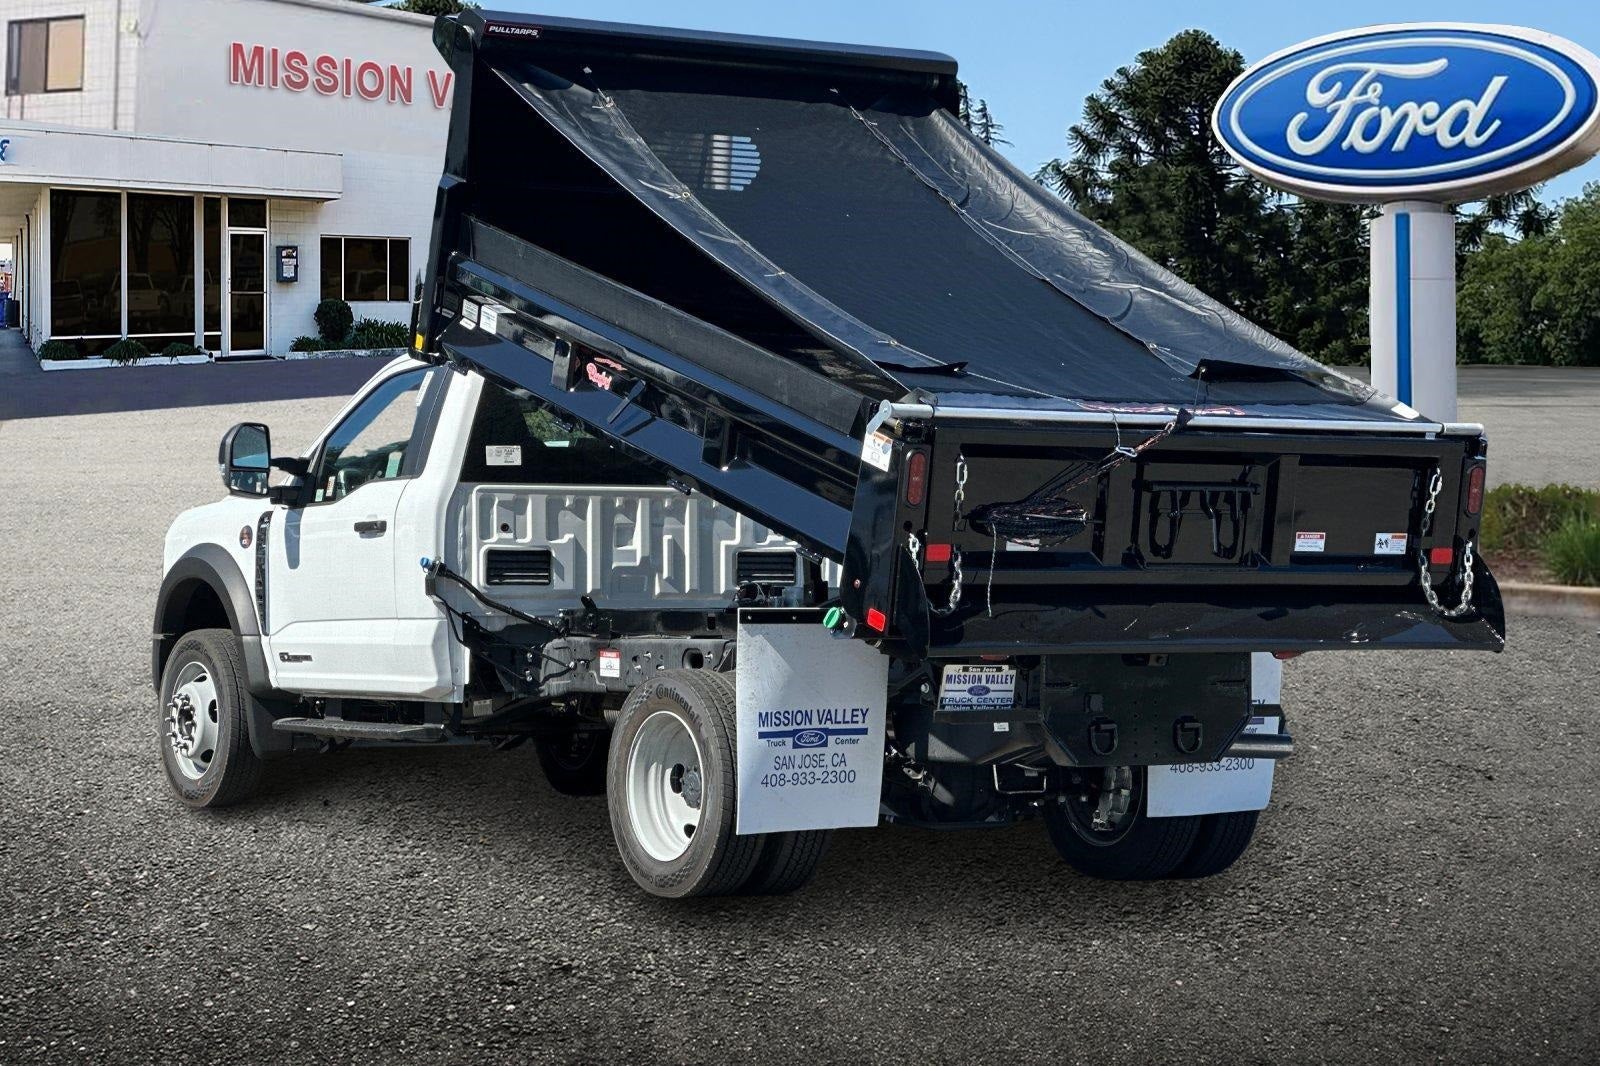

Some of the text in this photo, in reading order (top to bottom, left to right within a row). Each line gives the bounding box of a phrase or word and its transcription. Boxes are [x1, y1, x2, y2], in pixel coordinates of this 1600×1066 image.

[489, 26, 539, 36] PULLTARPS
[230, 41, 413, 105] MISSION
[1286, 57, 1509, 156] Ford
[945, 674, 1015, 684] MISSION VALLEY
[758, 708, 869, 728] MISSION VALLEY
[767, 739, 786, 748] Truck
[801, 732, 820, 743] Ford
[835, 737, 860, 745] Center
[774, 752, 847, 770] SAN JOSE, CA
[761, 769, 856, 788] 408-933-2300
